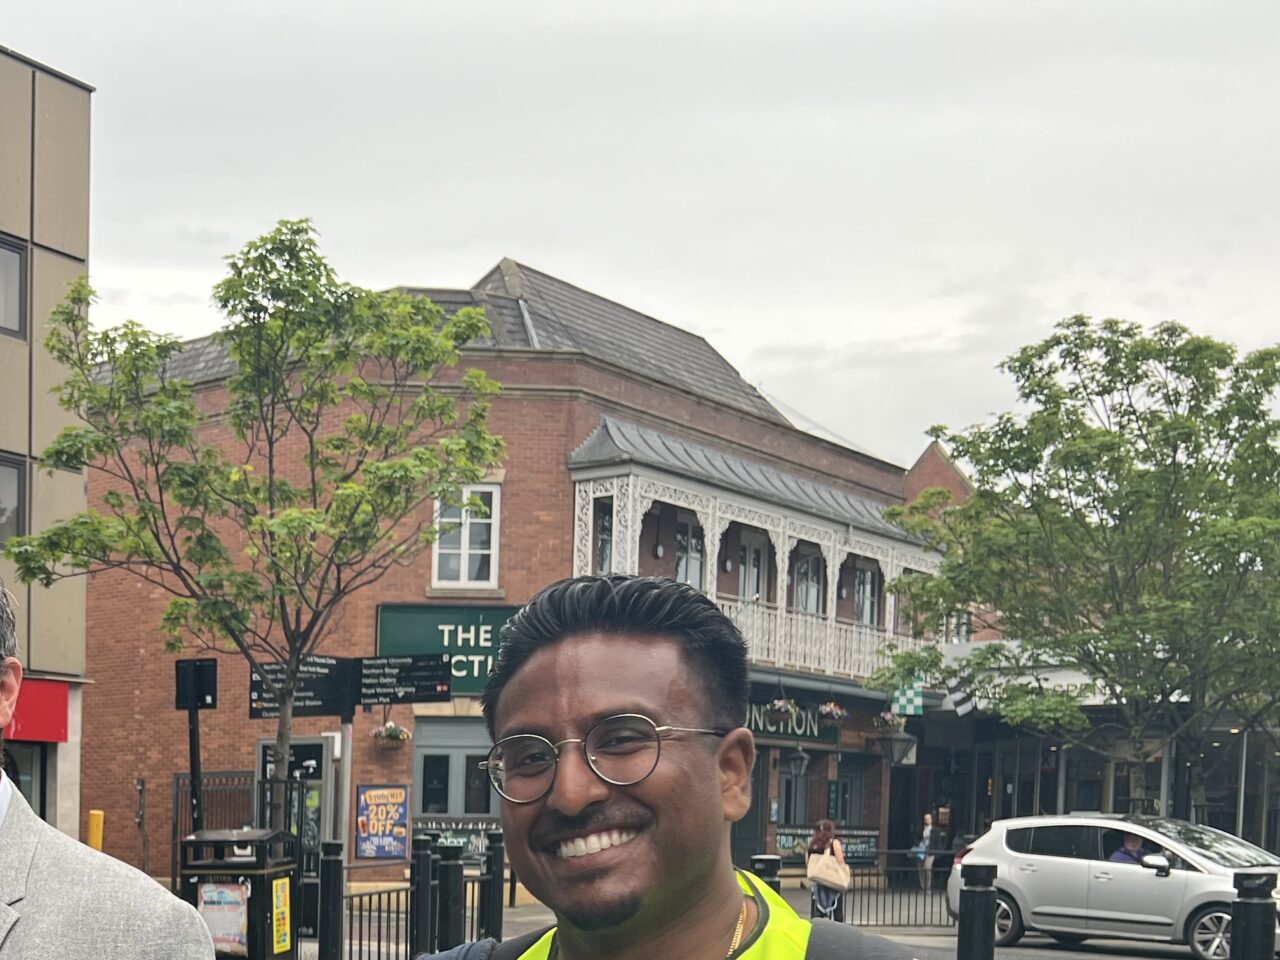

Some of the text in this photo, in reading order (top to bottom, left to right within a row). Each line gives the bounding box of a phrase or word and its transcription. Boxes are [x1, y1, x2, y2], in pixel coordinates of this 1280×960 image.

[437, 624, 493, 647] THE
[451, 654, 494, 678] CTI
[368, 804, 400, 820] 20%
[369, 820, 394, 835] OFF
